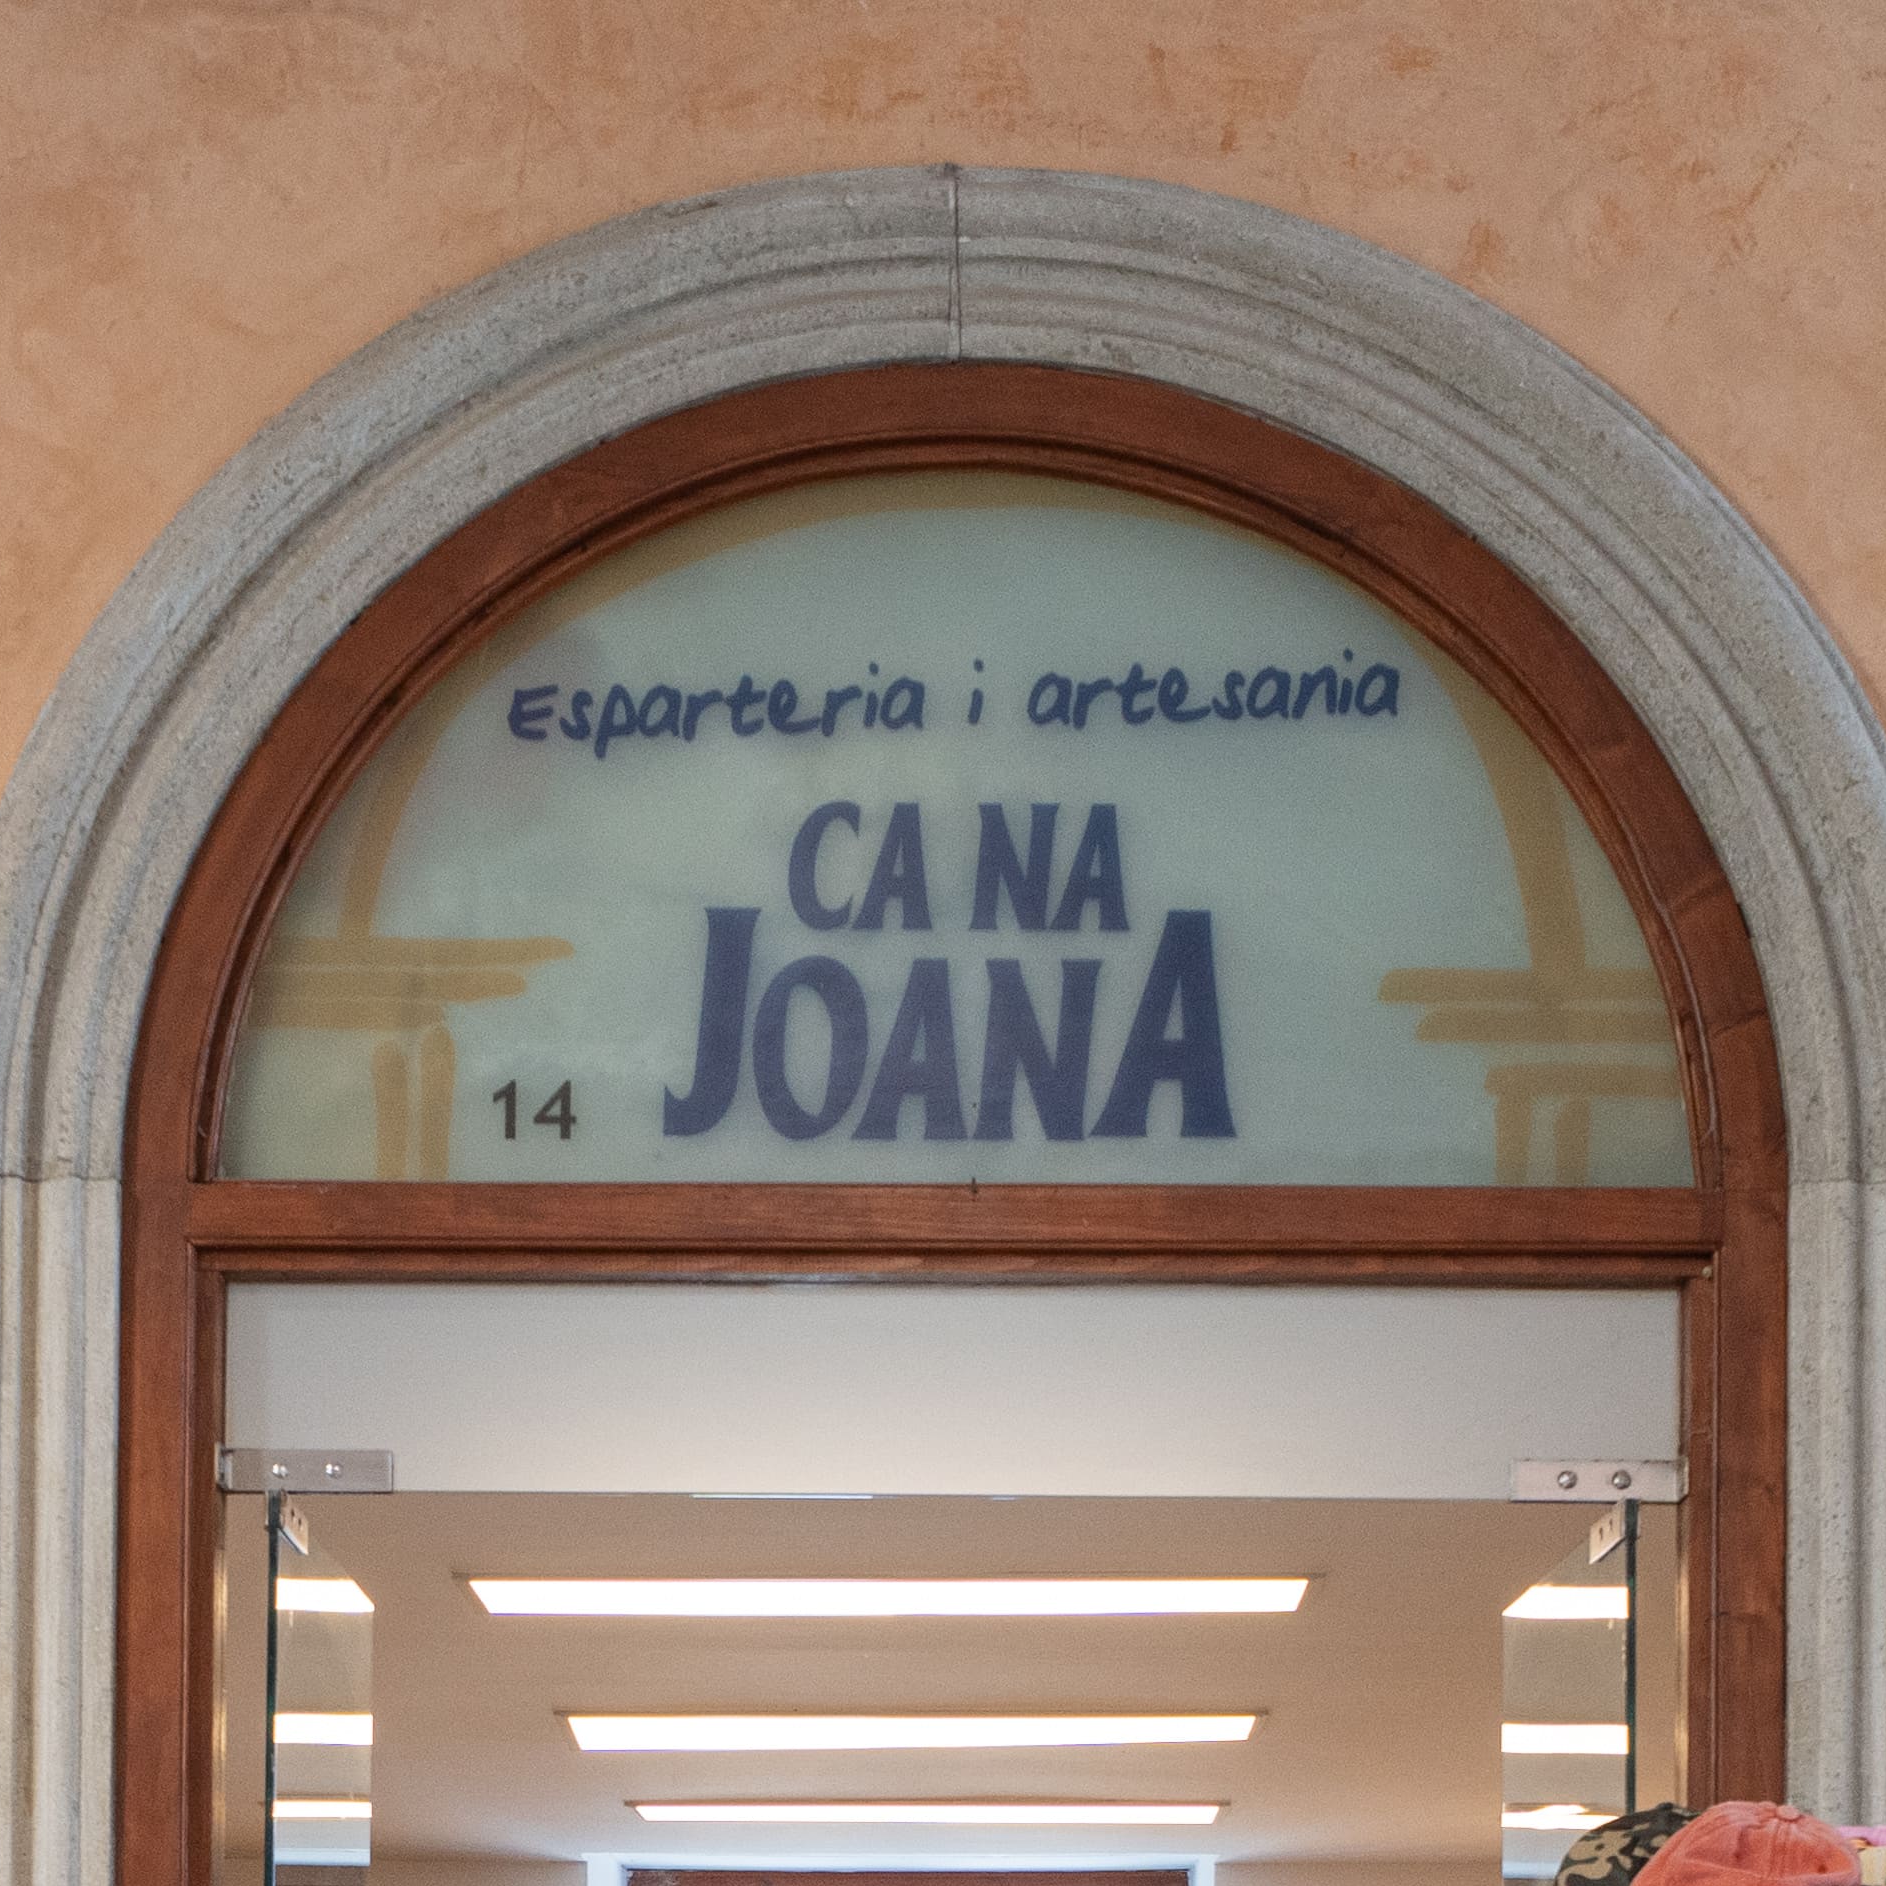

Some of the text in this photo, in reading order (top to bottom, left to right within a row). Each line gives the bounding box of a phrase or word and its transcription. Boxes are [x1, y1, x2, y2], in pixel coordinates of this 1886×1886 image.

[507, 649, 1400, 758] Esparteria i artesania
[787, 800, 1131, 931] CA NA
[662, 906, 1237, 1141] JOANA
[492, 1079, 577, 1140] 14
